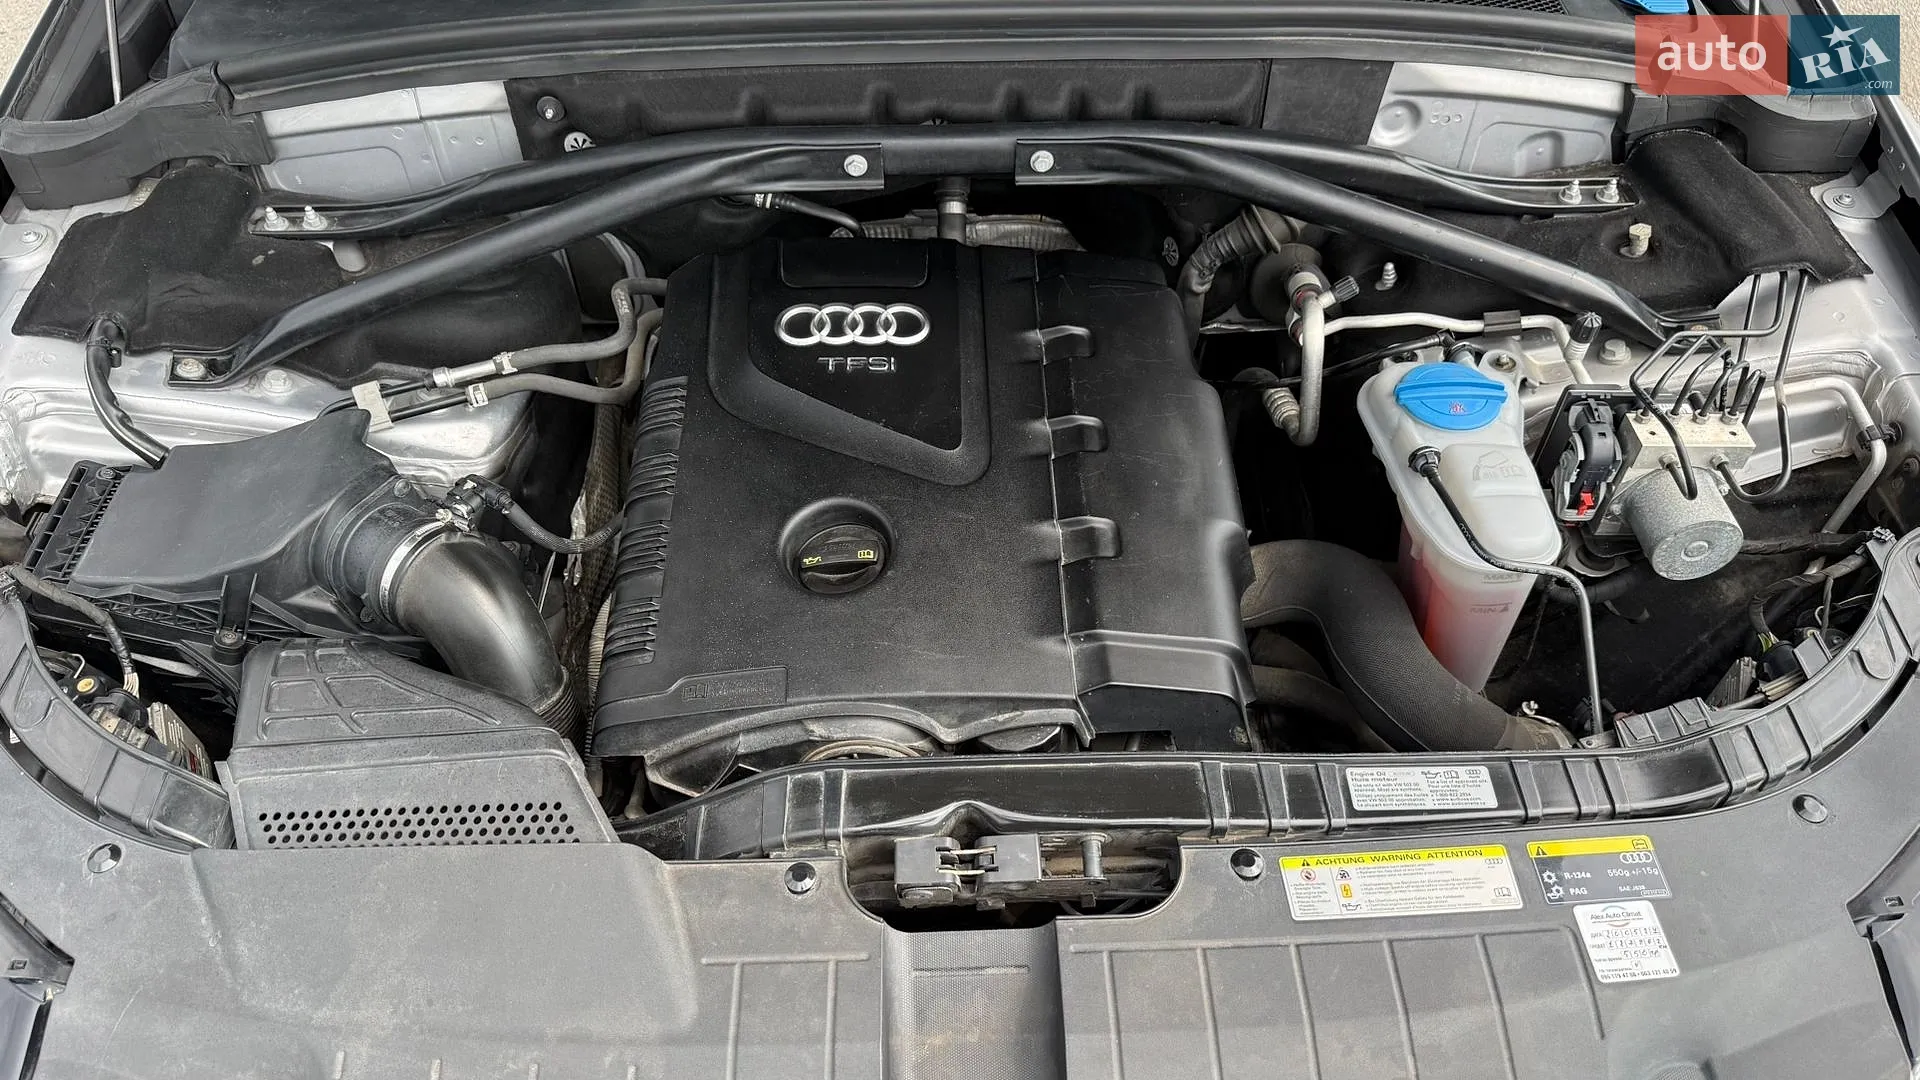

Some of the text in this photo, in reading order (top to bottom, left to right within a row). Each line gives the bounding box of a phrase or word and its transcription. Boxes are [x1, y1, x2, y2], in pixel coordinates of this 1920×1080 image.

[817, 356, 897, 373] TFSI
[1315, 849, 1483, 866] ACHTUNG WARNING ATTENTION
[1607, 869, 1629, 877] 550g
[1569, 887, 1588, 895] PAG
